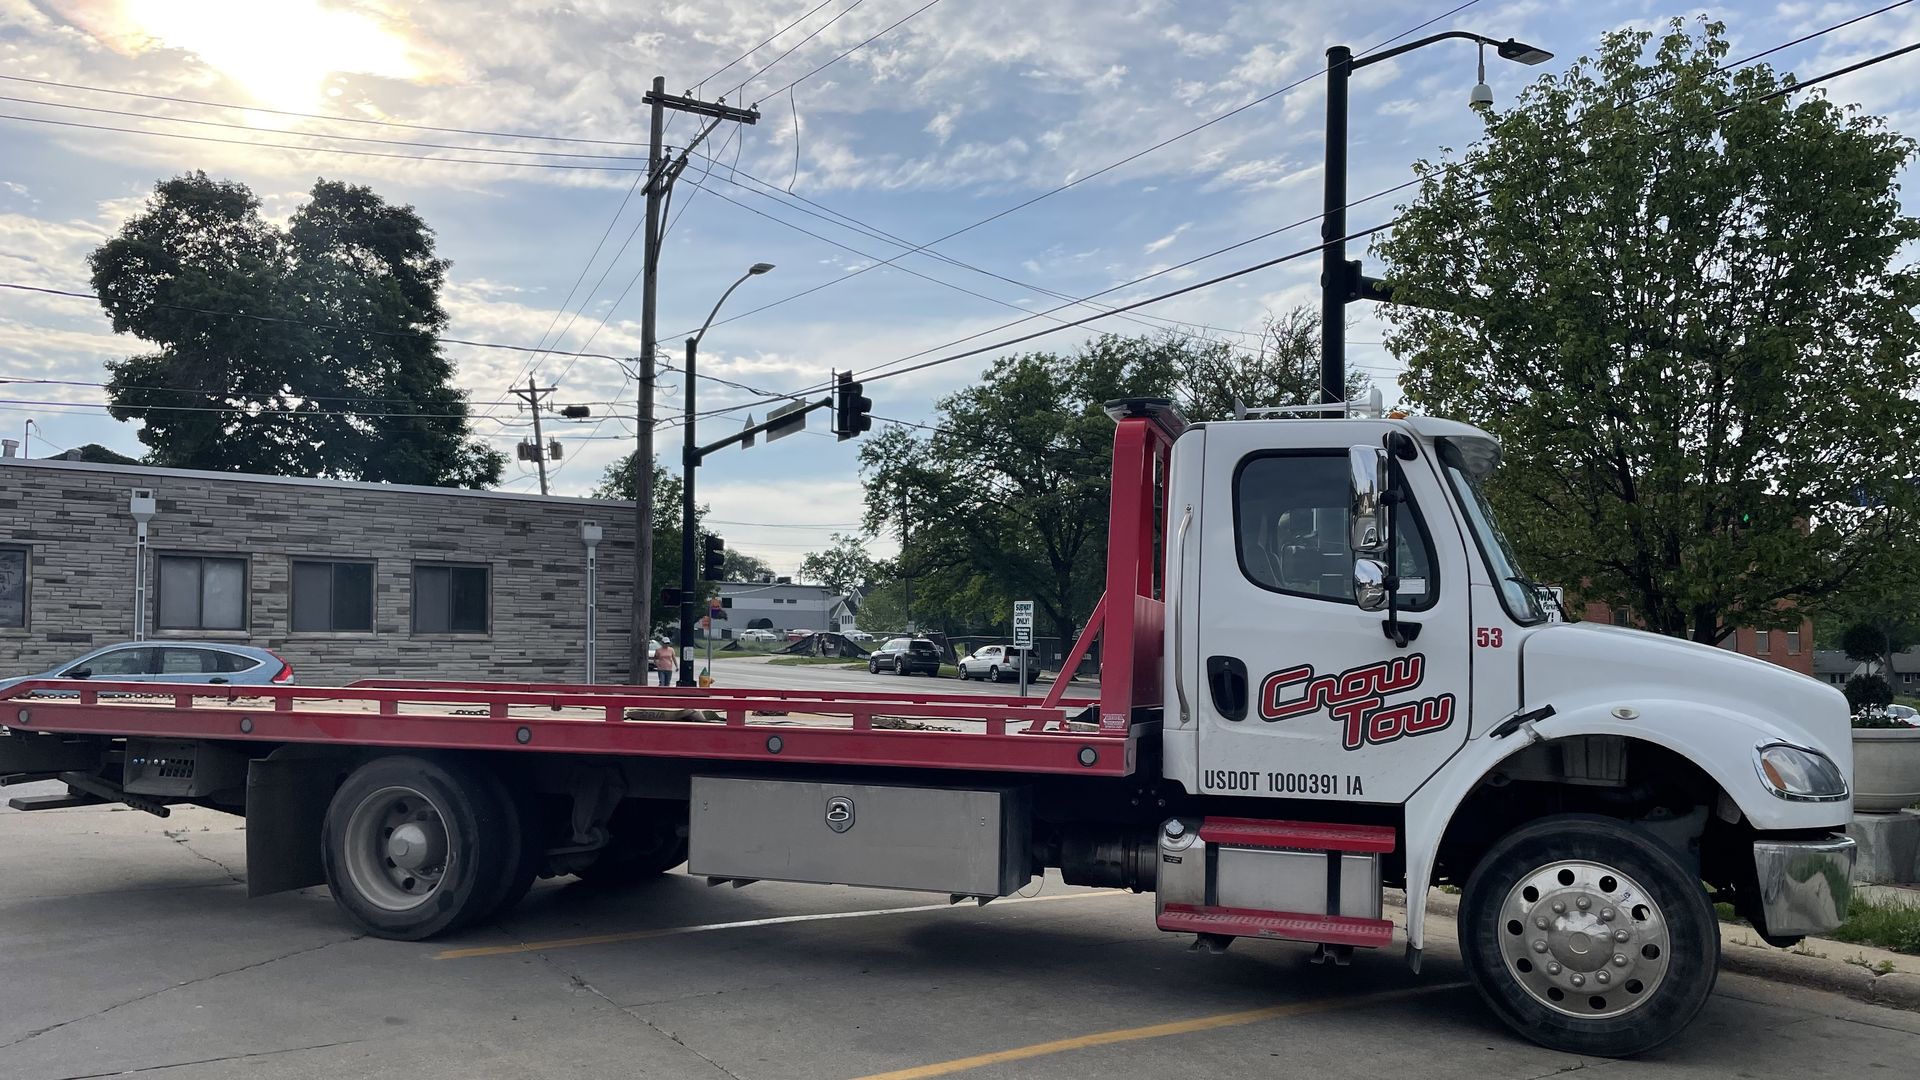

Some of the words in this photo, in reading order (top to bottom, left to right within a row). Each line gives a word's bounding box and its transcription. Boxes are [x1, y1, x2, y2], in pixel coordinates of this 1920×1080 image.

[1476, 627, 1503, 649] 53
[1329, 693, 1456, 751] Tow
[1204, 769, 1260, 791] USDOT
[1267, 772, 1338, 795] 1000391
[1346, 775, 1364, 796] IA
